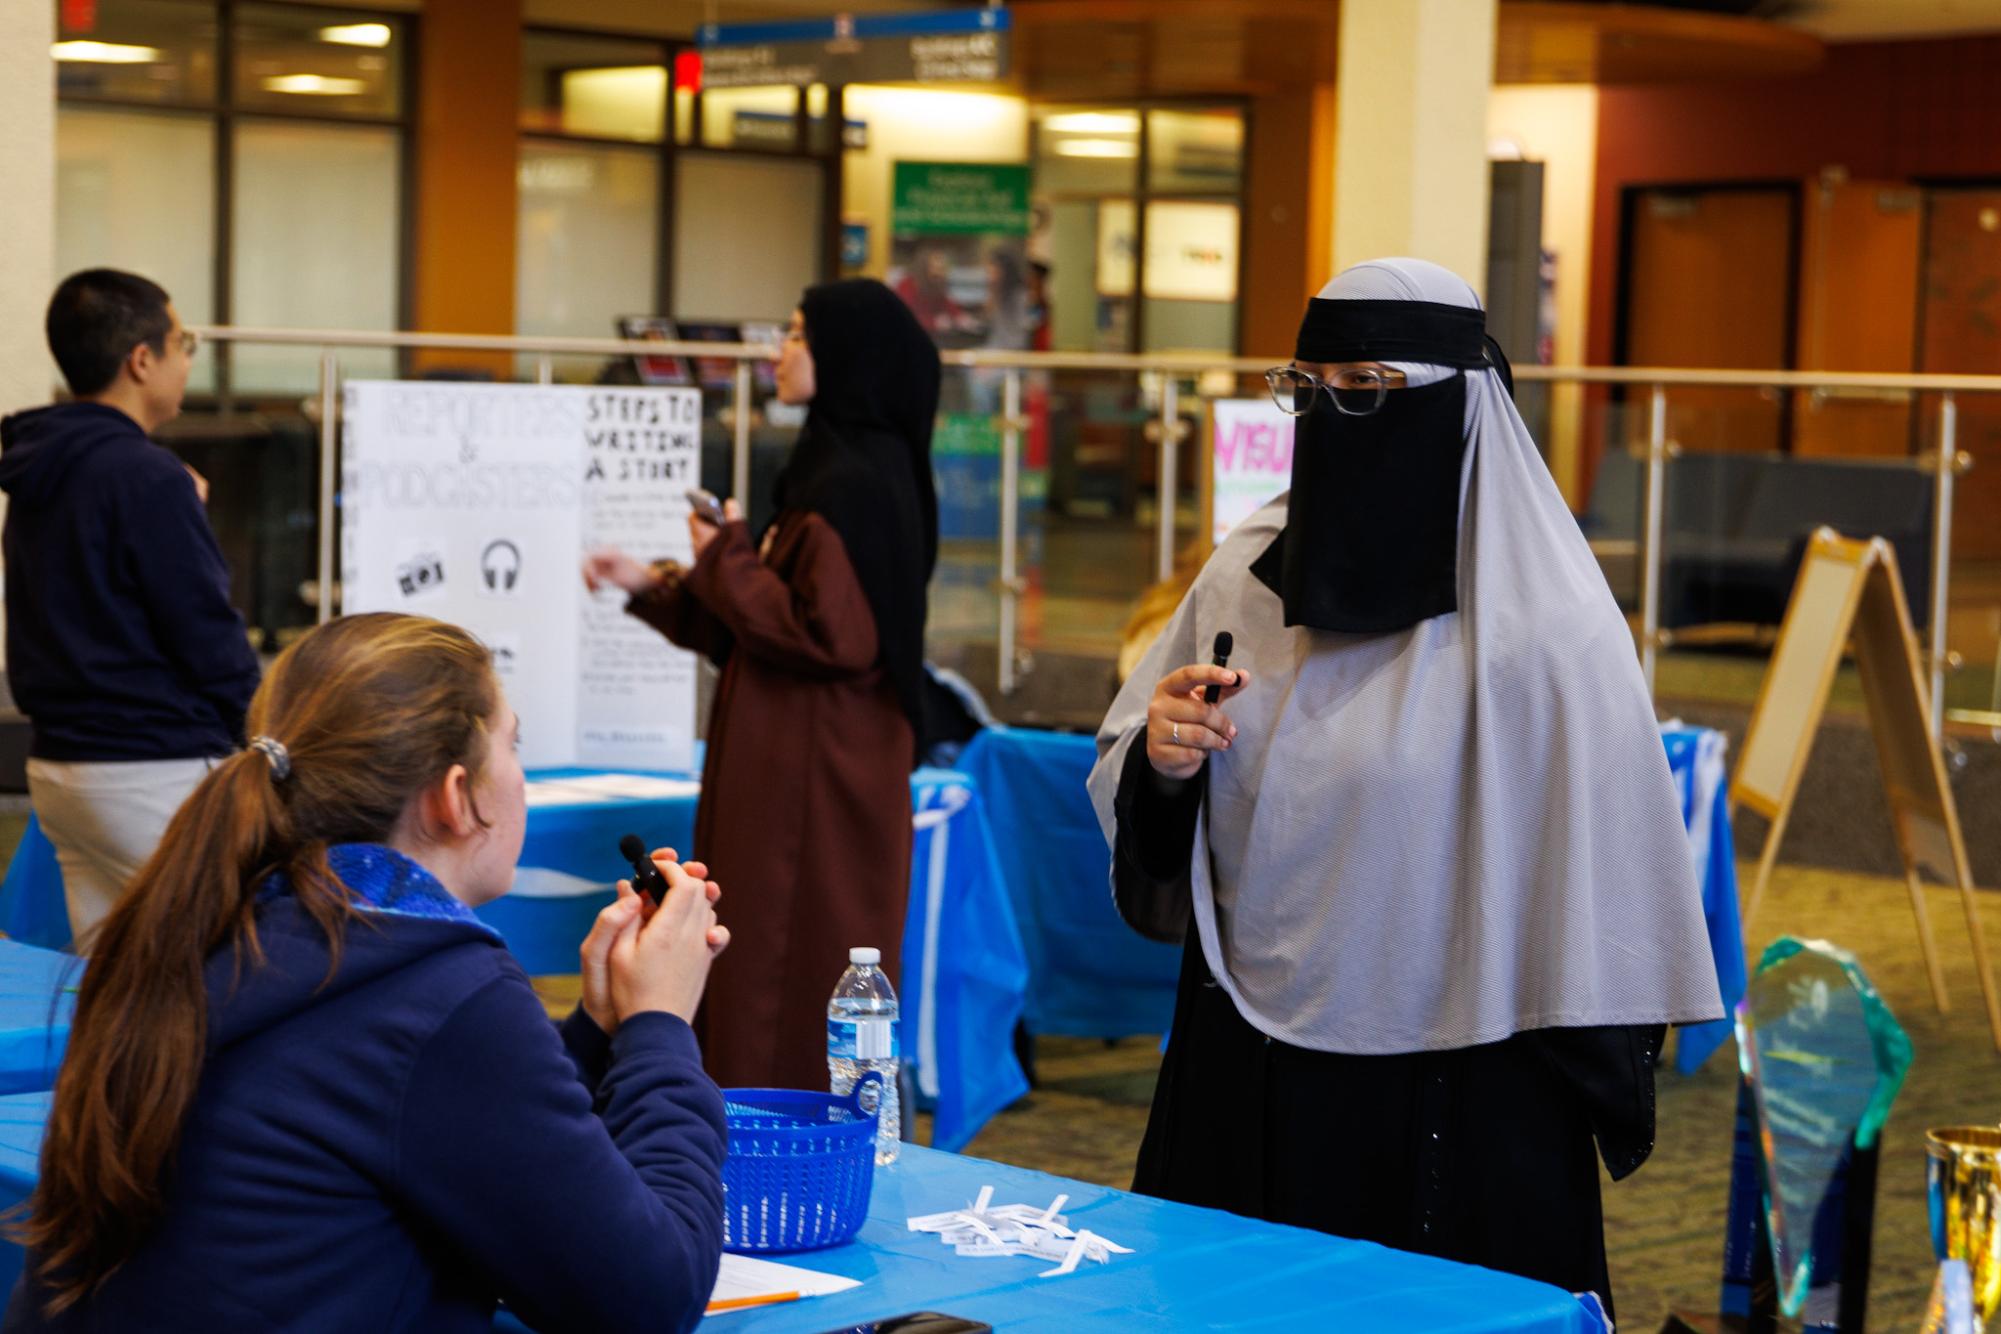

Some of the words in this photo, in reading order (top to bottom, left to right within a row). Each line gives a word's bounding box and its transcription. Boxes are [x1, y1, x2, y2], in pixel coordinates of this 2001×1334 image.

[385, 390, 579, 437] REPORTERS
[588, 394, 659, 424] STEPS
[669, 394, 695, 423] TO
[457, 433, 481, 464] &
[584, 429, 695, 452] WRITING
[585, 457, 605, 481] A
[619, 457, 688, 480] STORY
[362, 460, 579, 509] PODCASTERS
